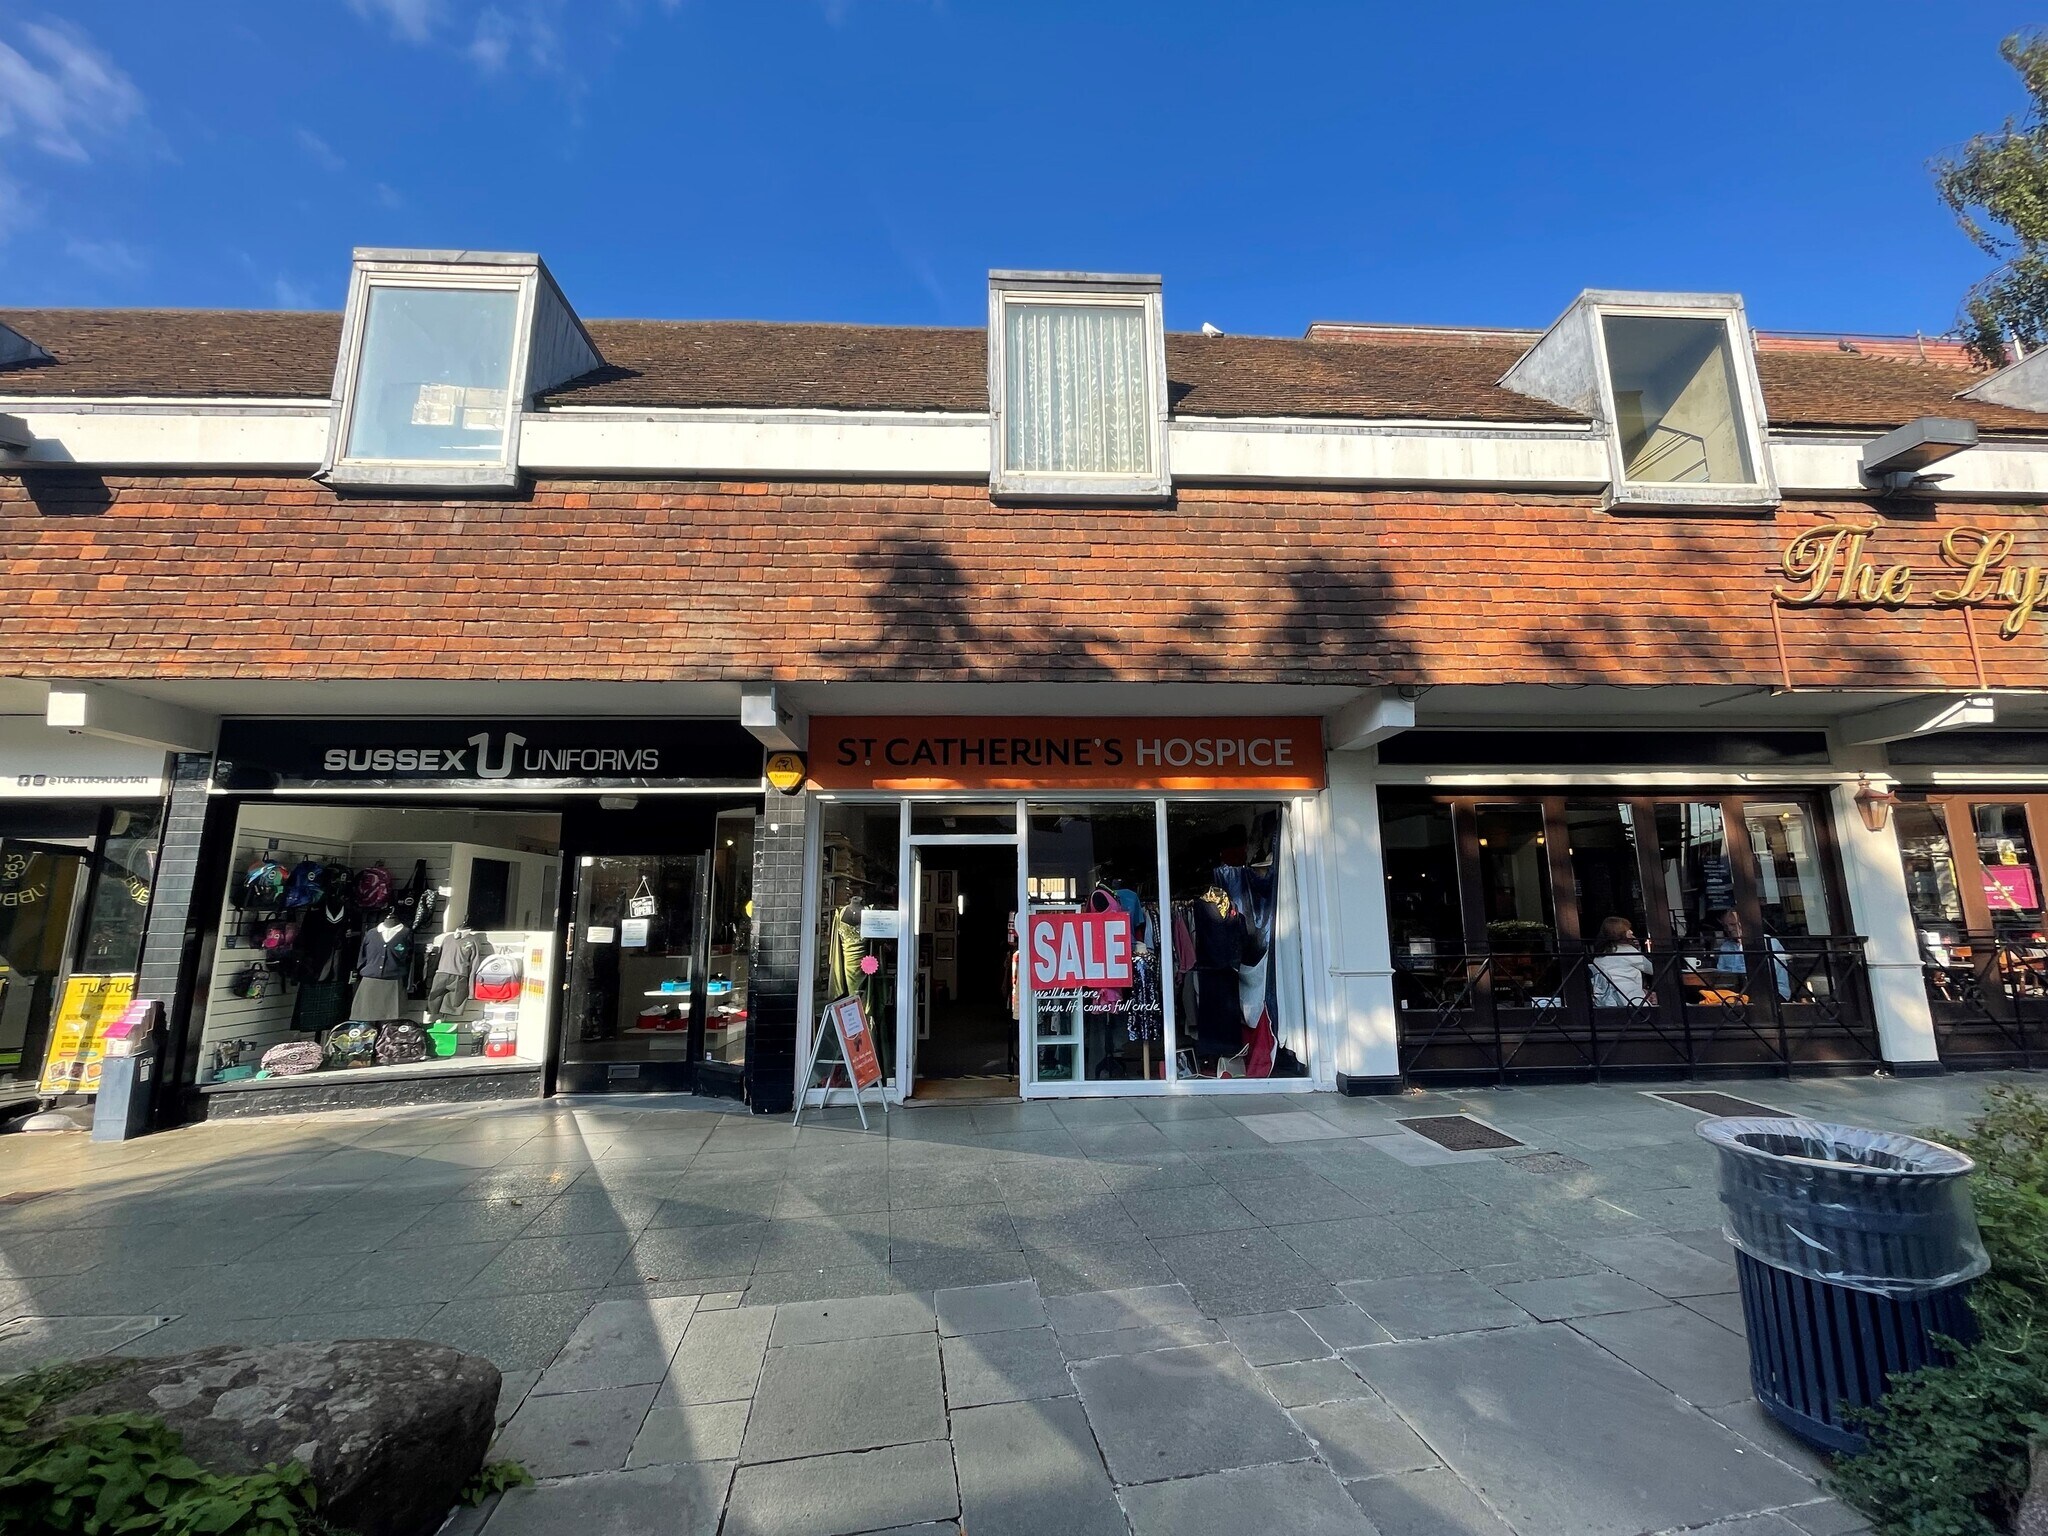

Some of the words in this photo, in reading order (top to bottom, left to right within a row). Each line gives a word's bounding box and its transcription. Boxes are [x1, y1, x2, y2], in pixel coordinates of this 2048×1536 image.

[1772, 521, 1914, 604] The
[1932, 525, 2048, 634] Ly
[324, 749, 467, 771] SUSSEX
[524, 749, 659, 771] UNIFORMS
[885, 738, 1124, 767] CATHERINE'S
[1137, 738, 1294, 767] HOSPICE
[1034, 920, 1129, 983] SALE
[80, 982, 135, 993] TUKTUK
[1034, 988, 1058, 998] we'll
[1060, 988, 1072, 998] be
[1038, 1001, 1064, 1013] when
[1083, 1003, 1111, 1012] comes
[1113, 999, 1131, 1013] full
